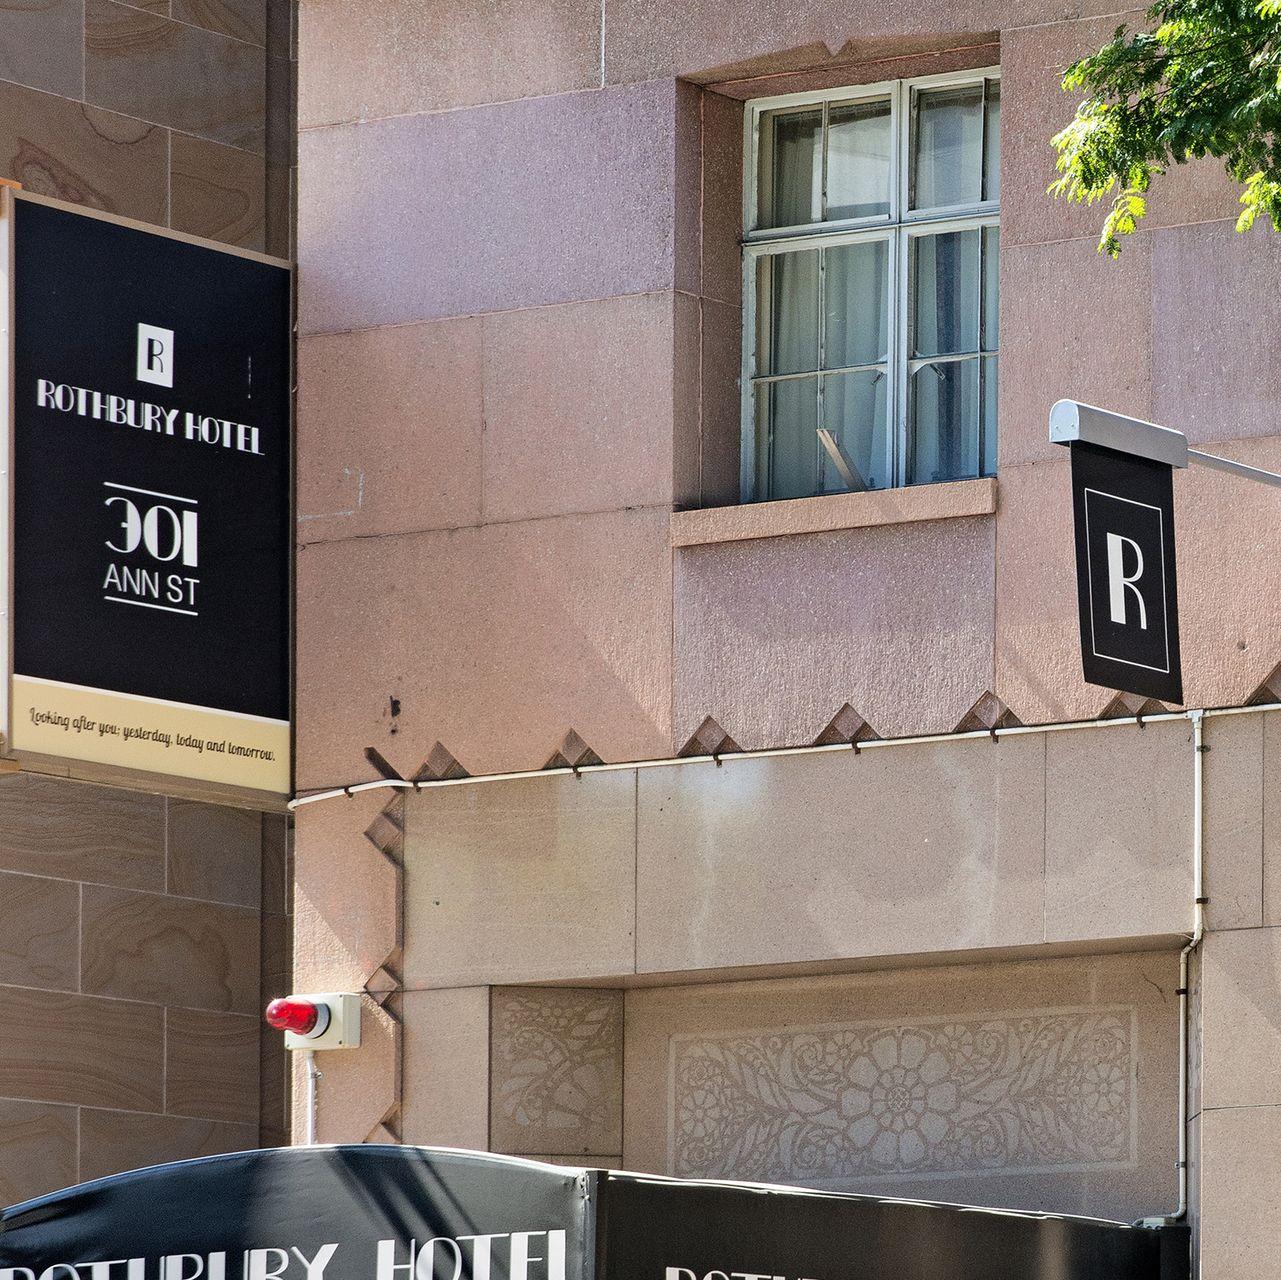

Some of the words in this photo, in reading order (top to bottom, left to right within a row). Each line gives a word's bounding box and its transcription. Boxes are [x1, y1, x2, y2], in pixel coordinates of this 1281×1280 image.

[146, 336, 165, 374] R
[37, 378, 180, 436] ROTHBURY
[185, 411, 265, 456] HOTEL
[104, 496, 199, 568] 301
[103, 563, 160, 599] ANN
[166, 574, 200, 606] ST
[1106, 531, 1148, 630] R
[29, 707, 70, 731] Looking
[72, 715, 97, 733] after
[176, 733, 204, 754] today
[206, 740, 226, 753] and
[228, 741, 276, 762] tomorrow.
